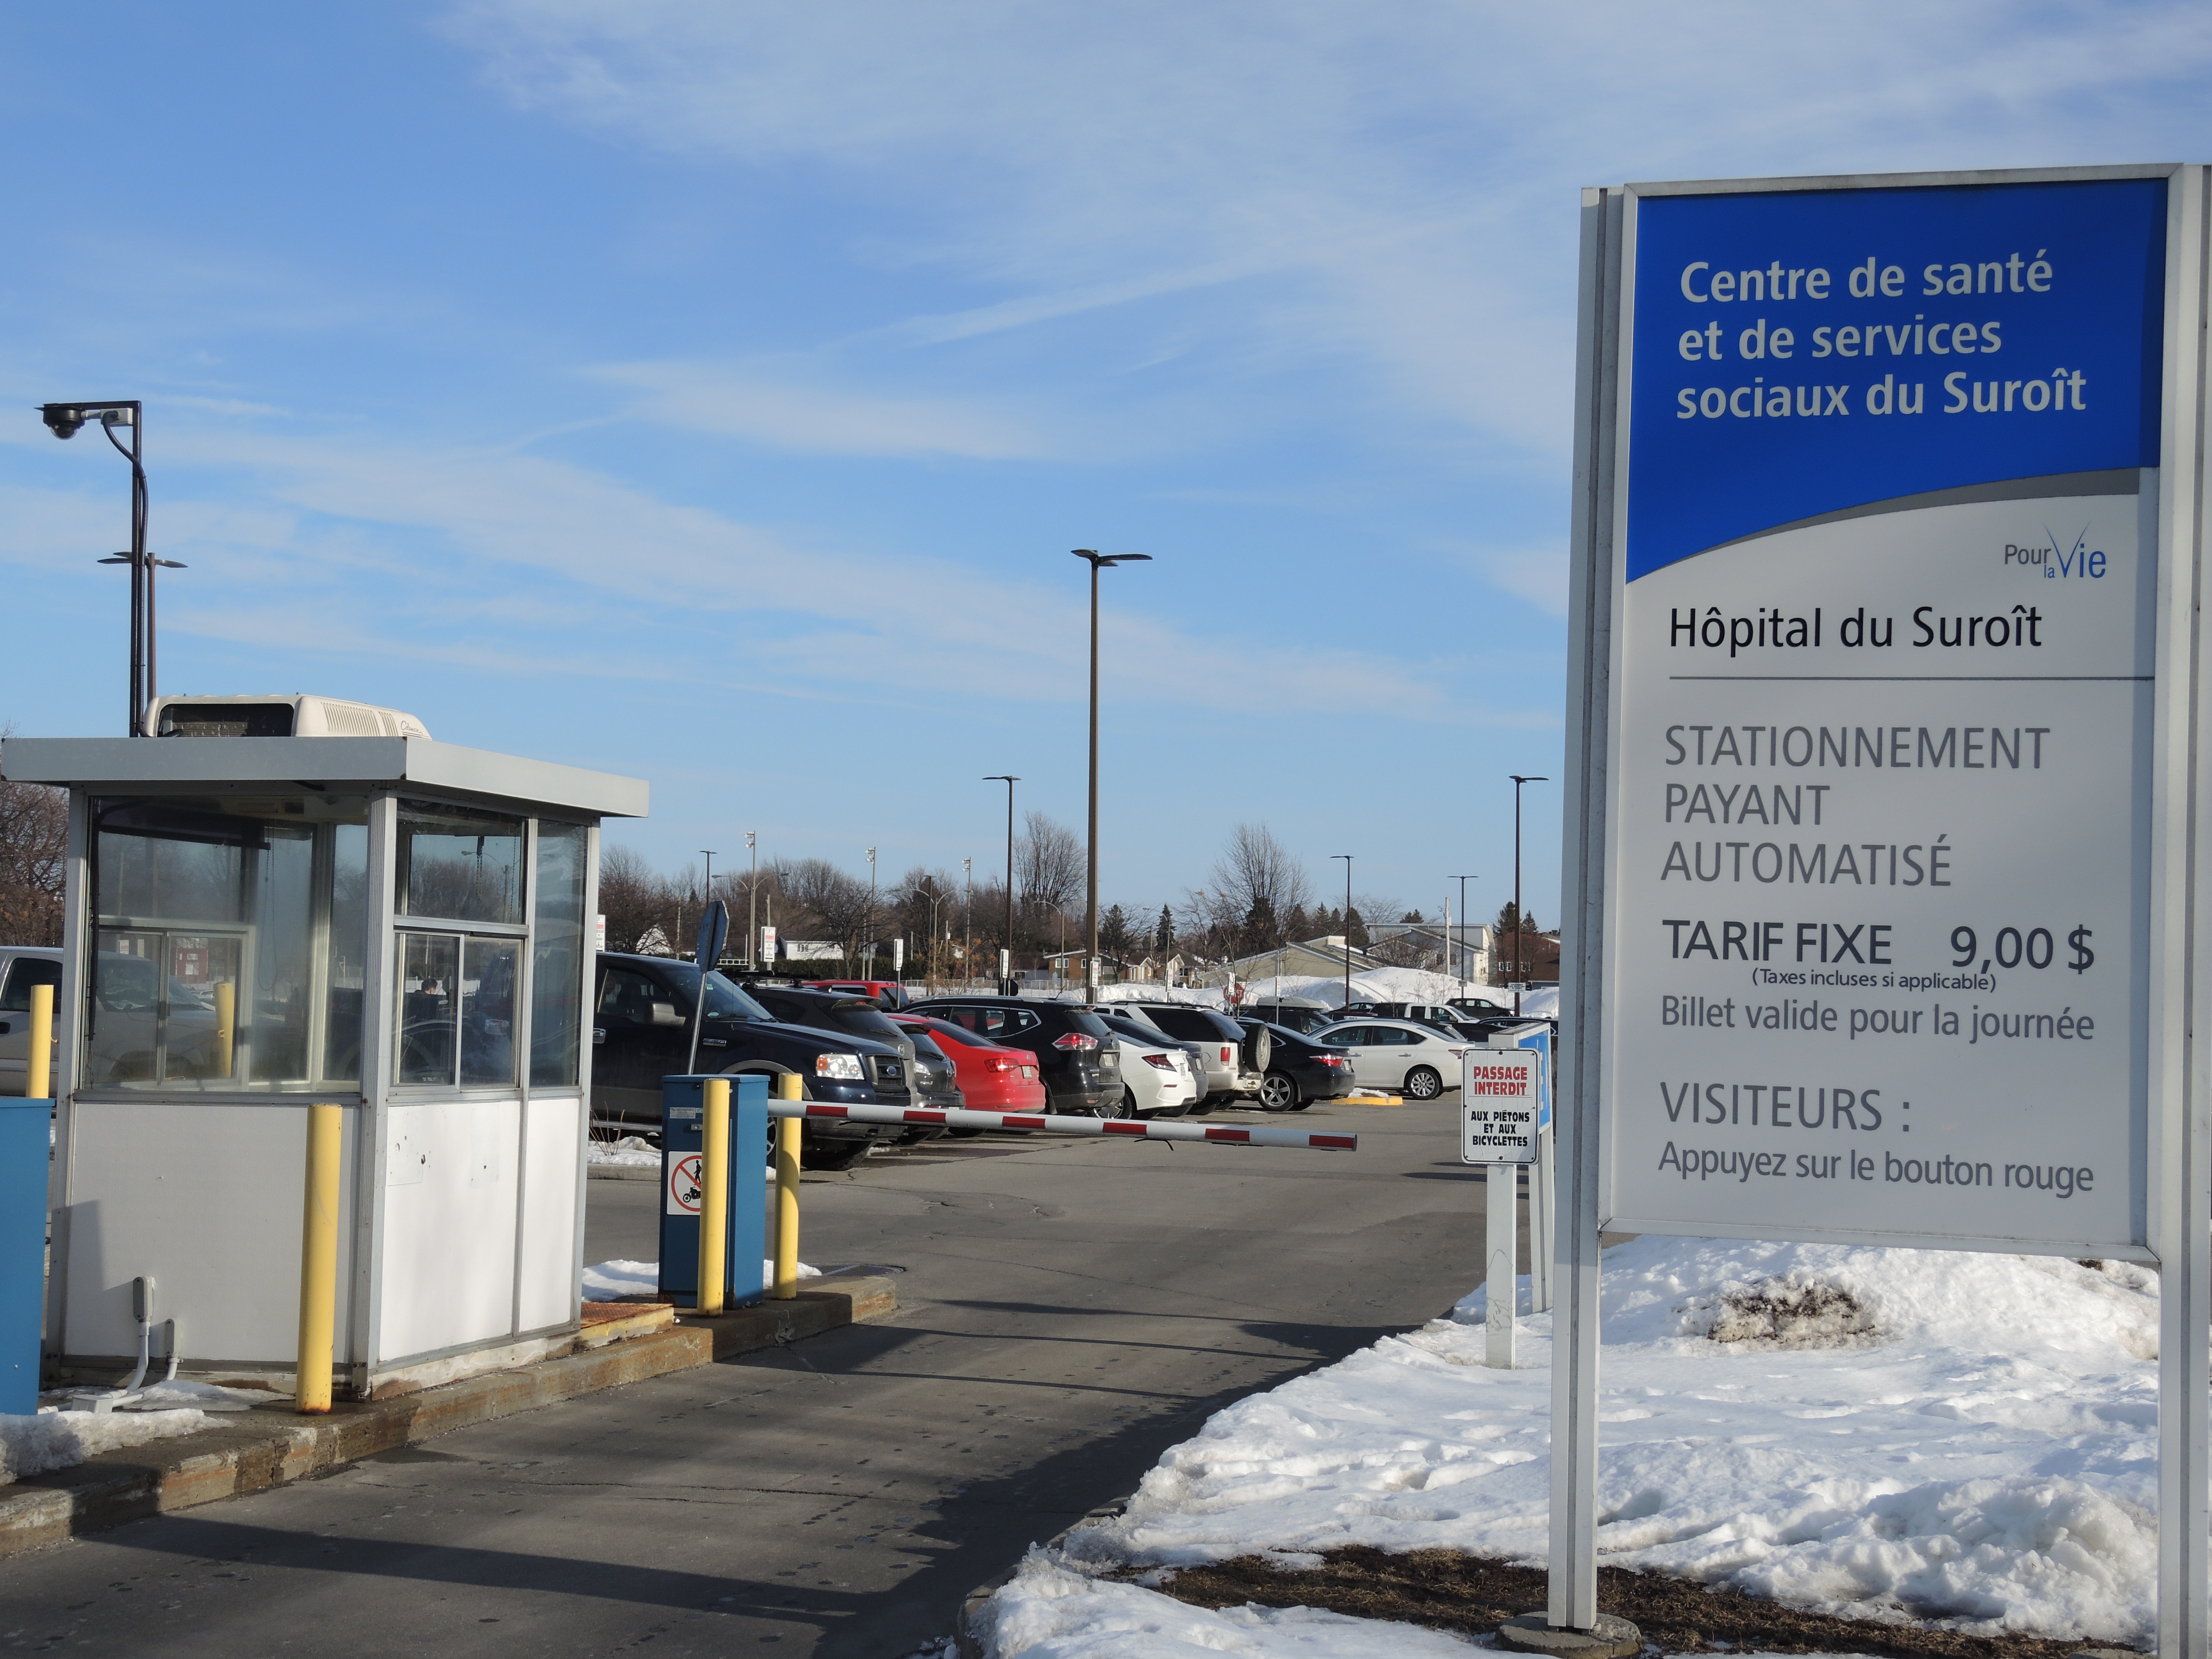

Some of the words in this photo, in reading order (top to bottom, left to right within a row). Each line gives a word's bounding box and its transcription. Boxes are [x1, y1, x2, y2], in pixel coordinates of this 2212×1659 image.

[1681, 260, 1830, 302] Centre
[1849, 257, 1905, 298] de
[1923, 249, 2052, 295] santé
[1679, 321, 1722, 361] et
[1739, 319, 1794, 359] de
[1812, 314, 2001, 357] services
[1677, 377, 1849, 419] sociaux
[1866, 374, 1923, 415] du
[1944, 368, 2086, 413] Suroît
[2005, 545, 2051, 565] Pour
[2042, 520, 2106, 578] Vie
[2044, 565, 2055, 578] la
[1671, 607, 1820, 658] Hôpital
[1840, 608, 1892, 647] du
[1913, 605, 2042, 646] Suroît
[1666, 726, 2050, 769] STATIONNEMENT
[1666, 784, 1830, 825] PAYANT
[1661, 834, 1950, 886] AUTOMATISÉ
[1662, 920, 1783, 961] TARIF
[1797, 924, 1891, 964] FIXE
[1951, 926, 2053, 974] 9,00
[2068, 925, 2094, 974] $
[1753, 968, 1806, 985] (Taxes
[1811, 970, 1877, 987] incluses
[1882, 971, 1893, 987] si
[1899, 973, 1996, 993] applicable)
[1663, 995, 1735, 1027] Billet
[1745, 999, 1837, 1031] valide
[1850, 1009, 1923, 1040] pour
[1934, 1004, 1958, 1035] la
[1969, 1005, 2094, 1044] journée
[1474, 1066, 1527, 1080] PASSAGE
[1475, 1082, 1526, 1095] INTERDIT
[1471, 1111, 1488, 1121] AUX
[1494, 1110, 1529, 1122] PIÉTONS
[1484, 1124, 1494, 1133] ET
[1499, 1124, 1516, 1134] AUX
[1660, 1082, 1881, 1131] VISITEURS
[1473, 1135, 1527, 1146] BICYCLETTES
[1658, 1141, 1786, 1182] Appuyez
[1796, 1155, 1841, 1178] sur
[1851, 1150, 1874, 1180] le
[1886, 1152, 1992, 1186] bouton
[2005, 1165, 2093, 1198] rouge
